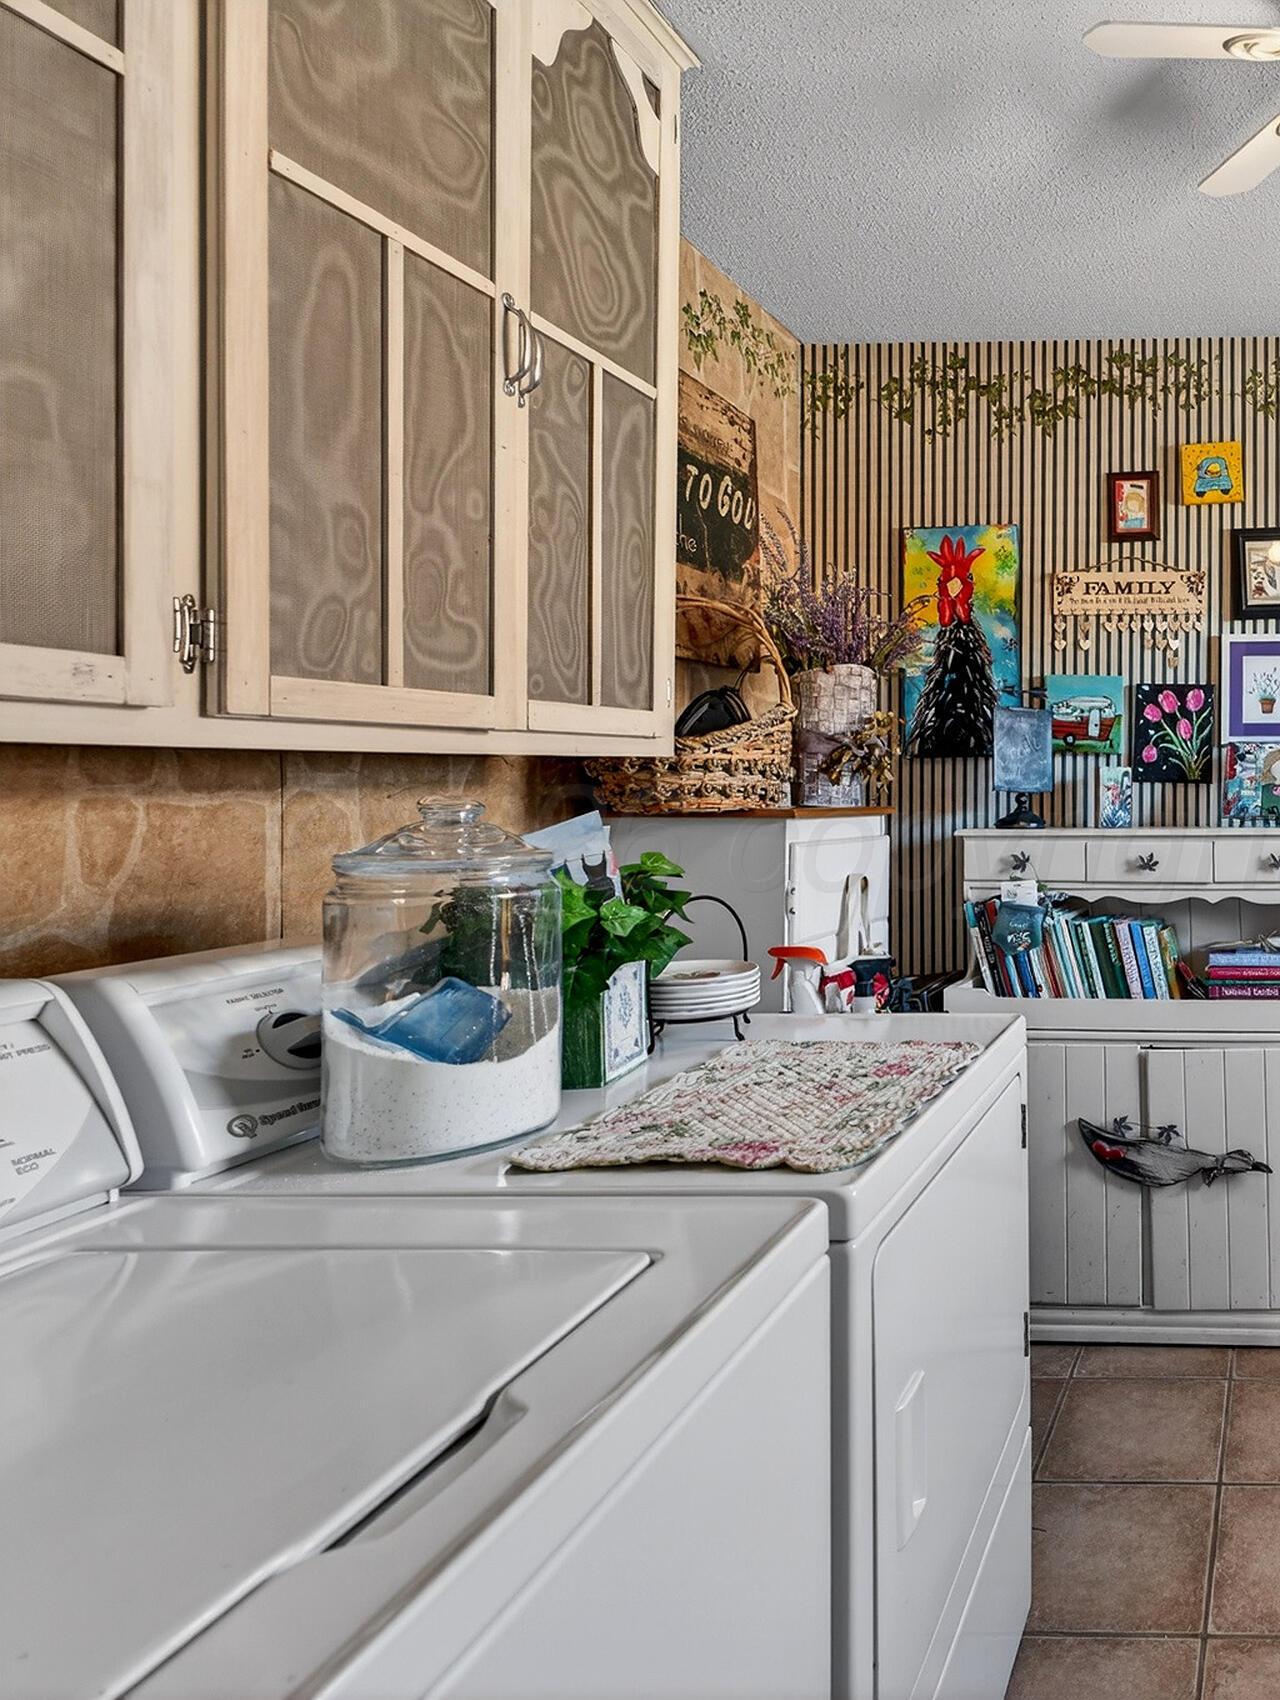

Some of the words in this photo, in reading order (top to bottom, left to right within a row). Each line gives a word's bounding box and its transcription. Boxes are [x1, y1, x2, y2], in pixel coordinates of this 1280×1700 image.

[685, 463, 712, 510] TO
[1083, 580, 1176, 595] FAMILY
[11, 1149, 56, 1166] NORMAL
[15, 1162, 39, 1176] ECO
